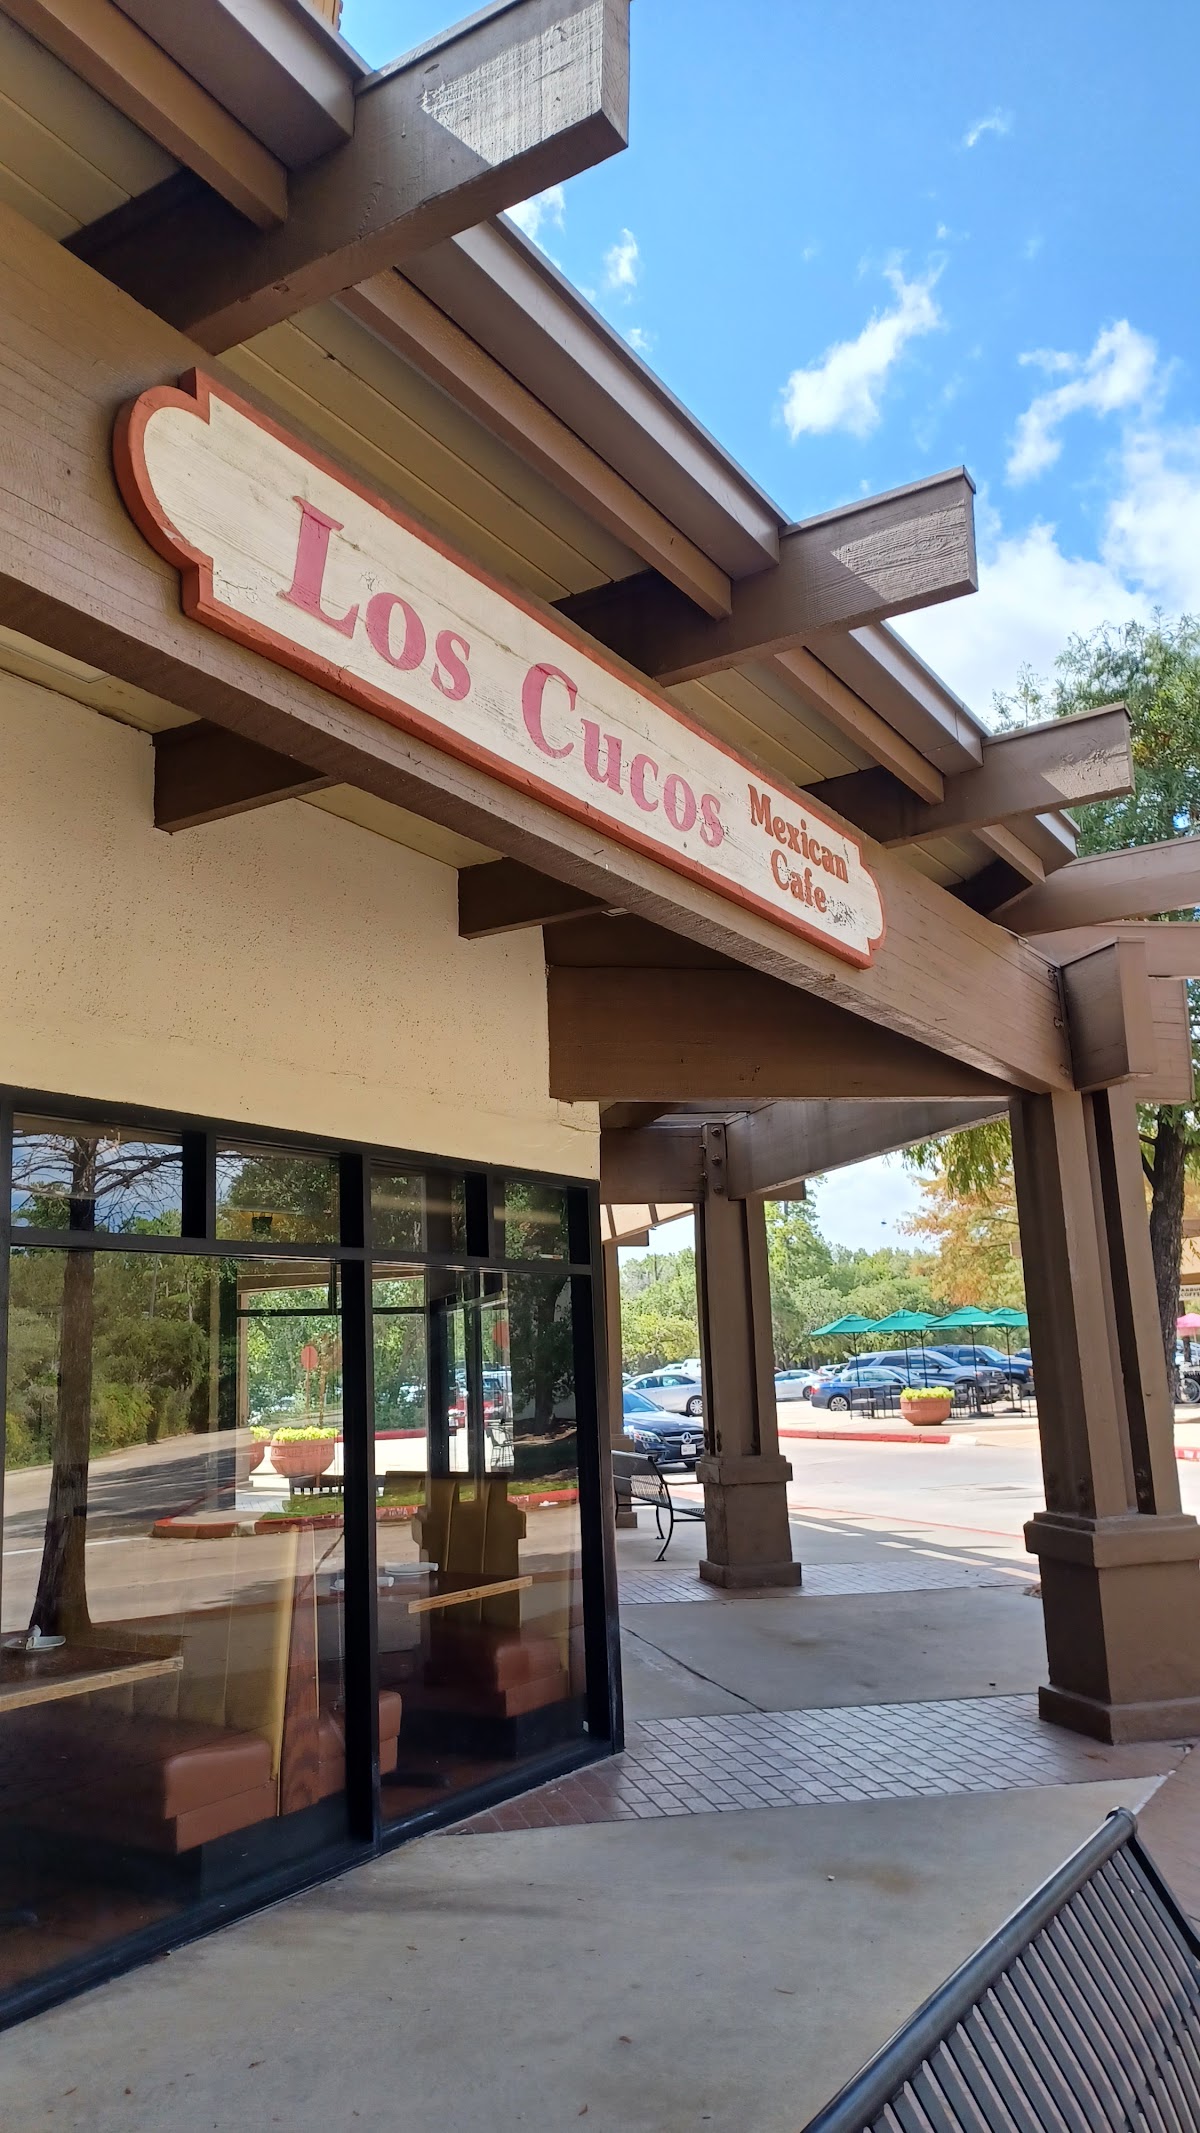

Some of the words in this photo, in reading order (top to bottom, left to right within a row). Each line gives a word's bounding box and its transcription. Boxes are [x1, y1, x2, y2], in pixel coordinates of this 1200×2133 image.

[276, 496, 472, 701] Los
[521, 662, 726, 848] Cucos
[747, 783, 849, 884] Mexican
[770, 849, 828, 913] Cafe
